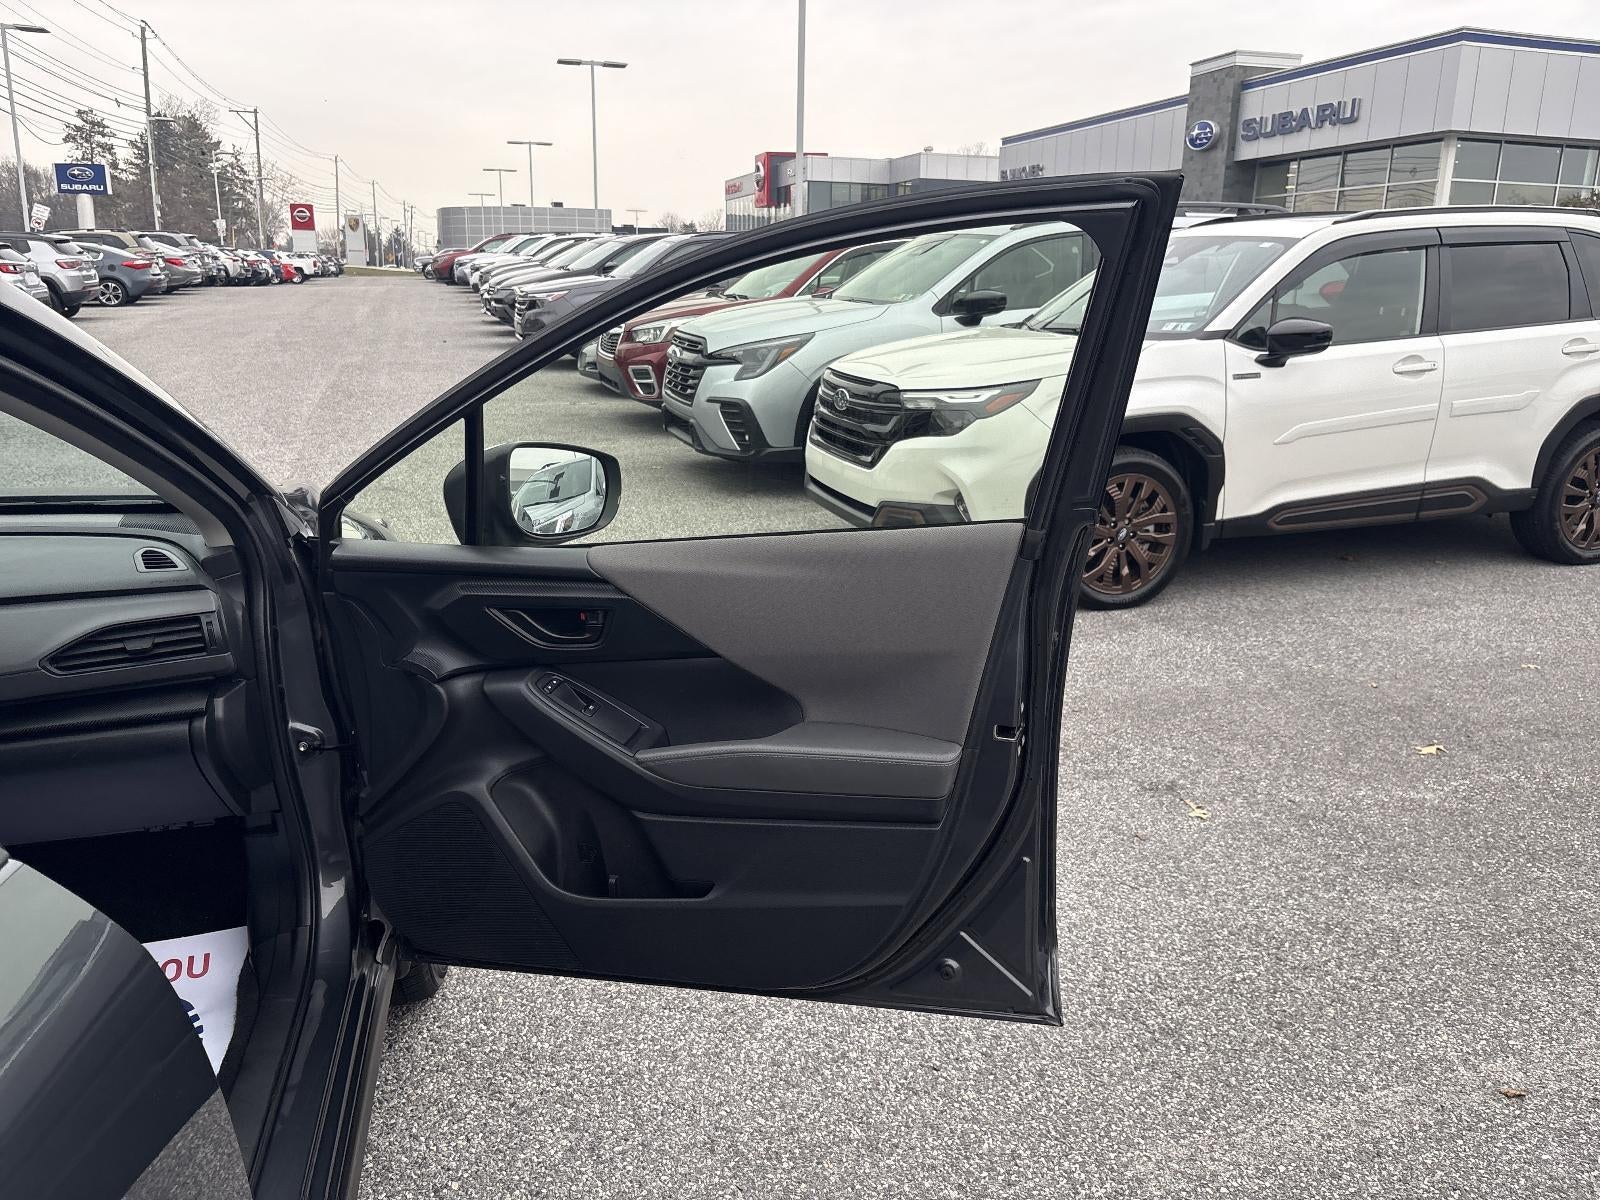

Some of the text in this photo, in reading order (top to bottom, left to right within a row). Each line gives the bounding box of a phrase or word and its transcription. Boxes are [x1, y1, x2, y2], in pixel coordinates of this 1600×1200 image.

[1240, 97, 1361, 142] SUBARU
[60, 183, 104, 191] SUBARU
[158, 952, 211, 983] OU
